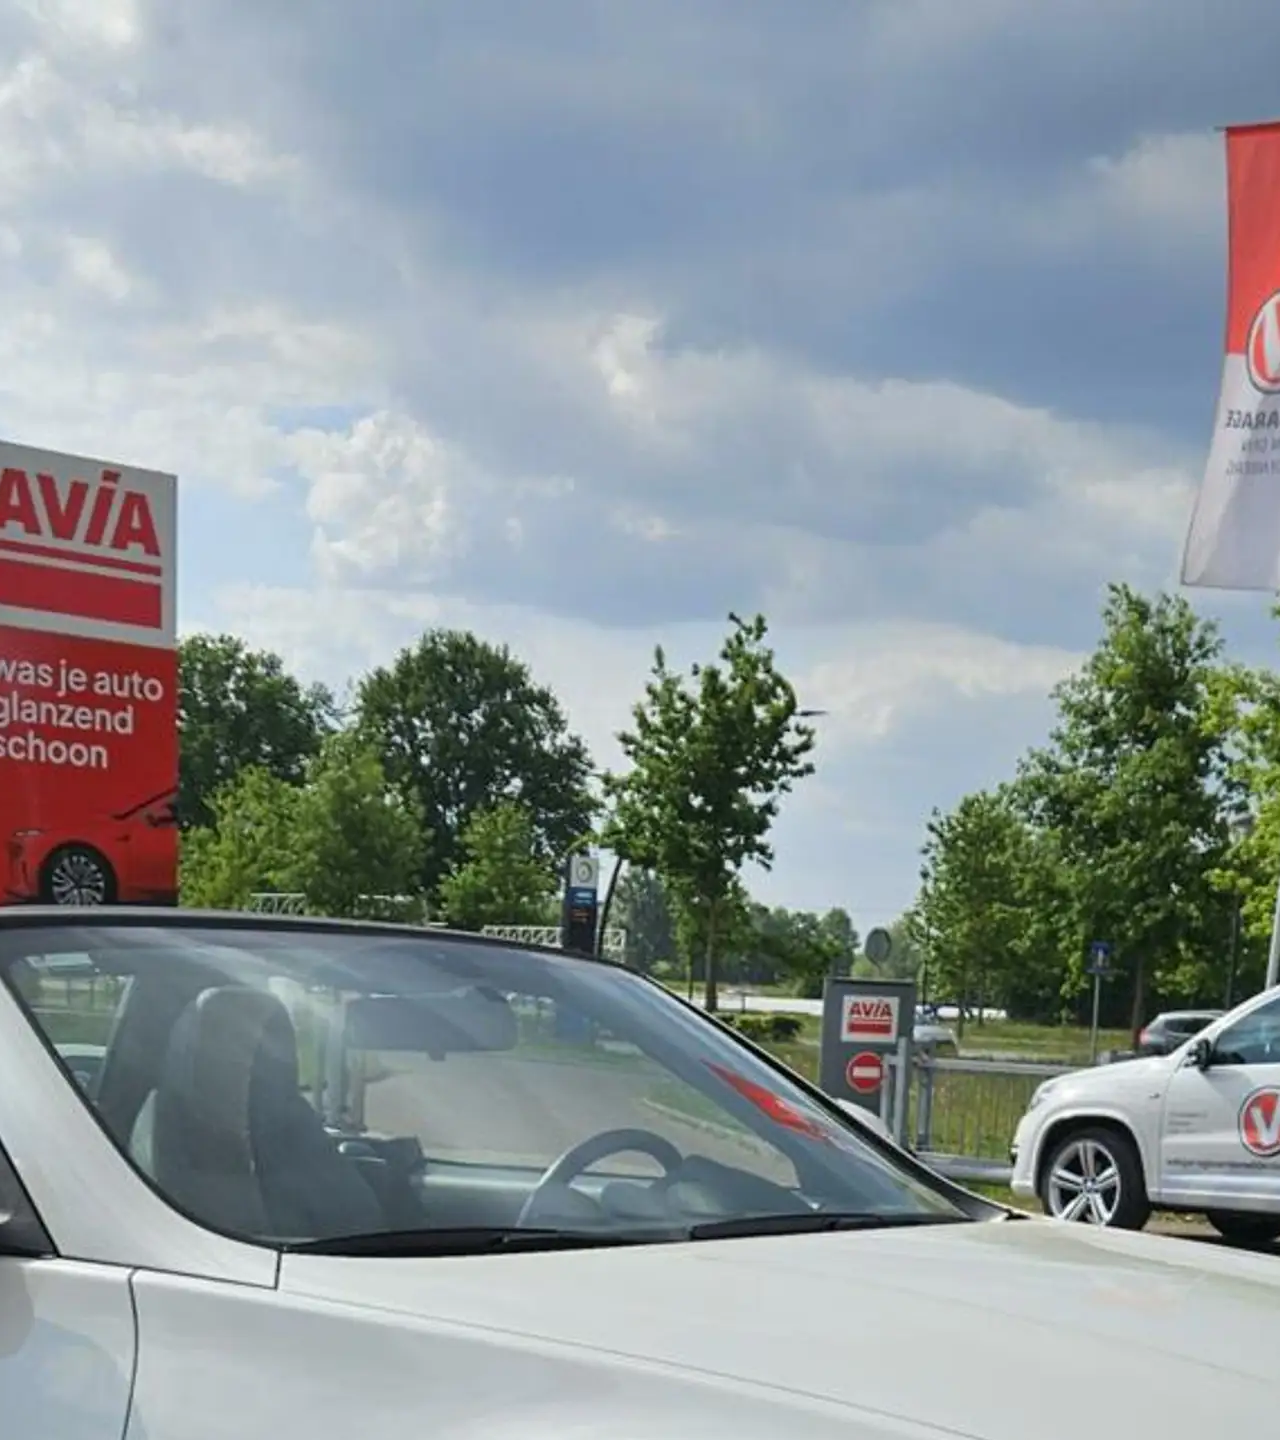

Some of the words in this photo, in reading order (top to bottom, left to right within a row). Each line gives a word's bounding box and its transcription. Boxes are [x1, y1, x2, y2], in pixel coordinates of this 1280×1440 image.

[57, 658, 88, 700] je
[93, 674, 164, 702] auto
[848, 999, 893, 1016] AVIA
